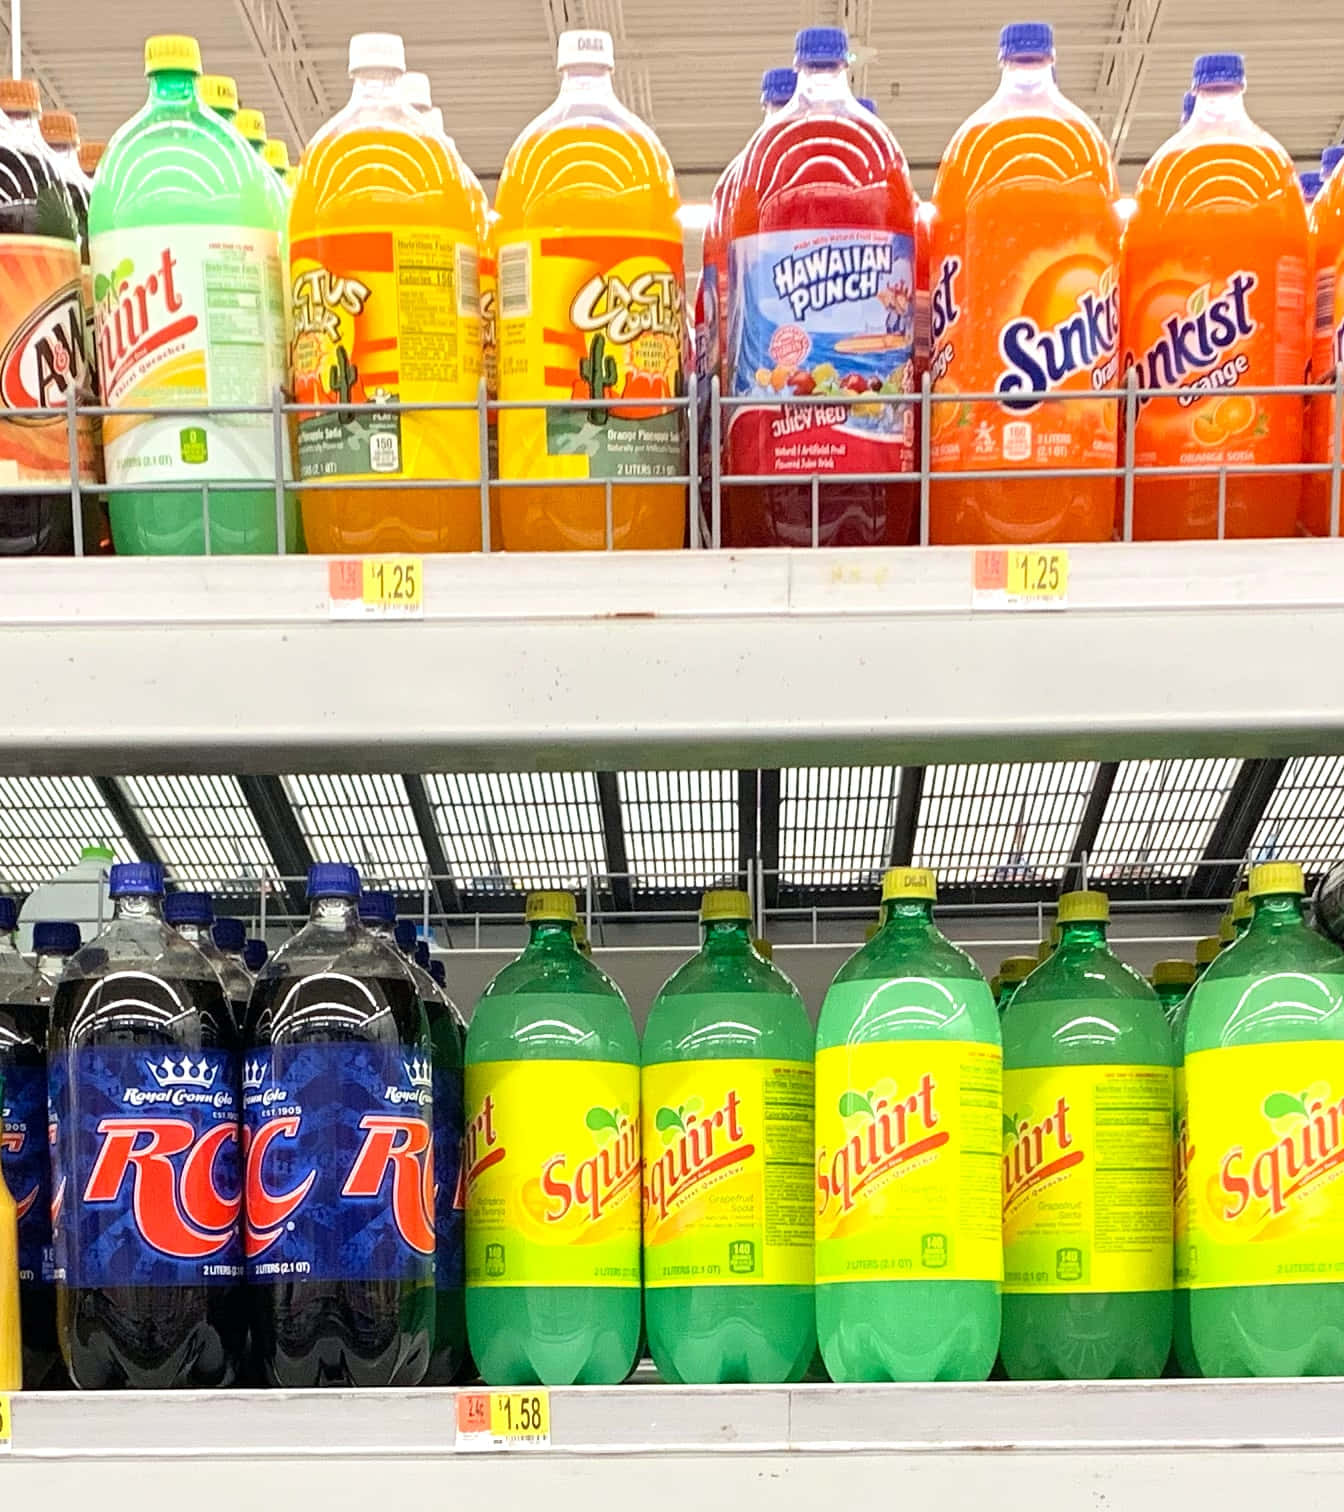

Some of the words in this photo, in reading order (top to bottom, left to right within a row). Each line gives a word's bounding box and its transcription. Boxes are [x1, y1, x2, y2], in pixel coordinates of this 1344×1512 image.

[773, 244, 892, 291] HAWAIIAN
[787, 271, 880, 321] PUNCH
[123, 1087, 171, 1104] Royal
[172, 1087, 212, 1104] Crown
[214, 1091, 233, 1105] Cola
[817, 1075, 939, 1216] Squirt
[85, 1118, 240, 1257] RC
